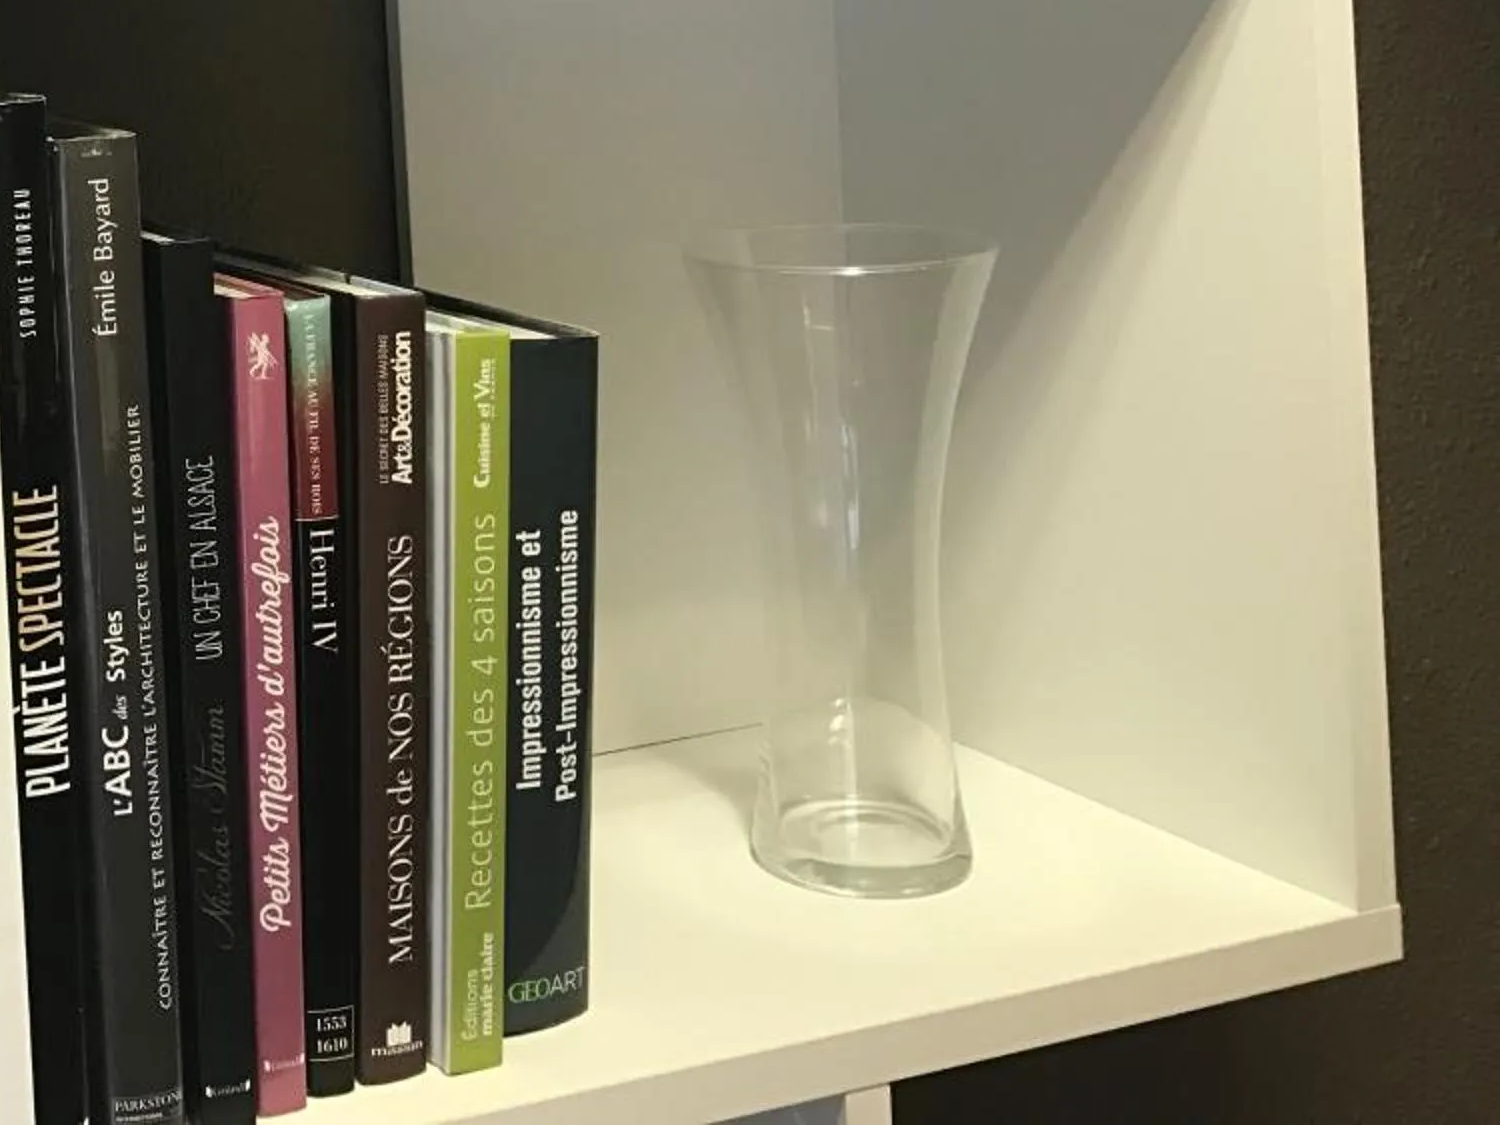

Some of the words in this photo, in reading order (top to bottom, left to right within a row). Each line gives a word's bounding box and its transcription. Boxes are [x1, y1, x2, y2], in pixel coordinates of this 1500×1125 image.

[13, 188, 33, 266] THOREAU
[88, 178, 118, 261] Bayard
[17, 276, 37, 338] SOPHIE
[92, 270, 118, 336] Émile
[377, 334, 389, 379] MAISONS
[473, 359, 492, 400] Vins
[377, 382, 389, 413] BELLES
[378, 416, 389, 434] DES
[390, 331, 413, 484] Art&Décoration
[127, 404, 145, 498] MOBILIER
[308, 435, 321, 454] DE
[309, 457, 322, 480] SES
[378, 438, 389, 471] SECRET
[473, 422, 491, 489] Cuisine
[185, 455, 217, 530] ALSACE
[311, 484, 323, 515] ROIS
[379, 474, 389, 484] LE
[132, 505, 145, 525] LE
[133, 532, 147, 553] ET
[515, 529, 542, 556] et
[12, 484, 65, 652] SPECTACLE
[190, 540, 219, 569] EN
[309, 529, 335, 610] Henri
[468, 513, 495, 642] saisons
[191, 576, 221, 624] CHEF
[251, 516, 291, 695] d'autrefois
[380, 534, 414, 683] RÉGIONS
[103, 610, 129, 683] Styles
[135, 560, 157, 717] L'ARCHITECTURE
[194, 631, 223, 660] UN
[312, 621, 339, 654] IV
[471, 655, 498, 676] 4
[555, 510, 582, 802] Post-Impressionnisme
[112, 695, 128, 720] des
[515, 566, 547, 790] Impressionnisme
[12, 657, 71, 798] PLANÈTE
[387, 692, 414, 763] NOS
[466, 689, 494, 746] des
[101, 725, 133, 816] L'ABC
[190, 700, 227, 813] Stamm
[260, 702, 293, 832] Métiers
[386, 769, 413, 805] de
[143, 723, 164, 860] RECONNAÎTRE
[465, 759, 493, 909] Recettes
[151, 867, 166, 889] ET
[196, 827, 236, 950] Nicolas
[260, 837, 292, 932] Petits
[387, 814, 414, 964] MAISONS
[151, 895, 172, 1010] CONNAÎTRE
[480, 932, 495, 980] claire
[508, 966, 586, 1003] GEOART
[316, 1015, 347, 1032] 1553
[461, 969, 479, 1040] Éditions
[481, 983, 494, 1036] marie
[316, 1037, 349, 1054] 1610
[115, 1090, 182, 1112] PARKSTON
